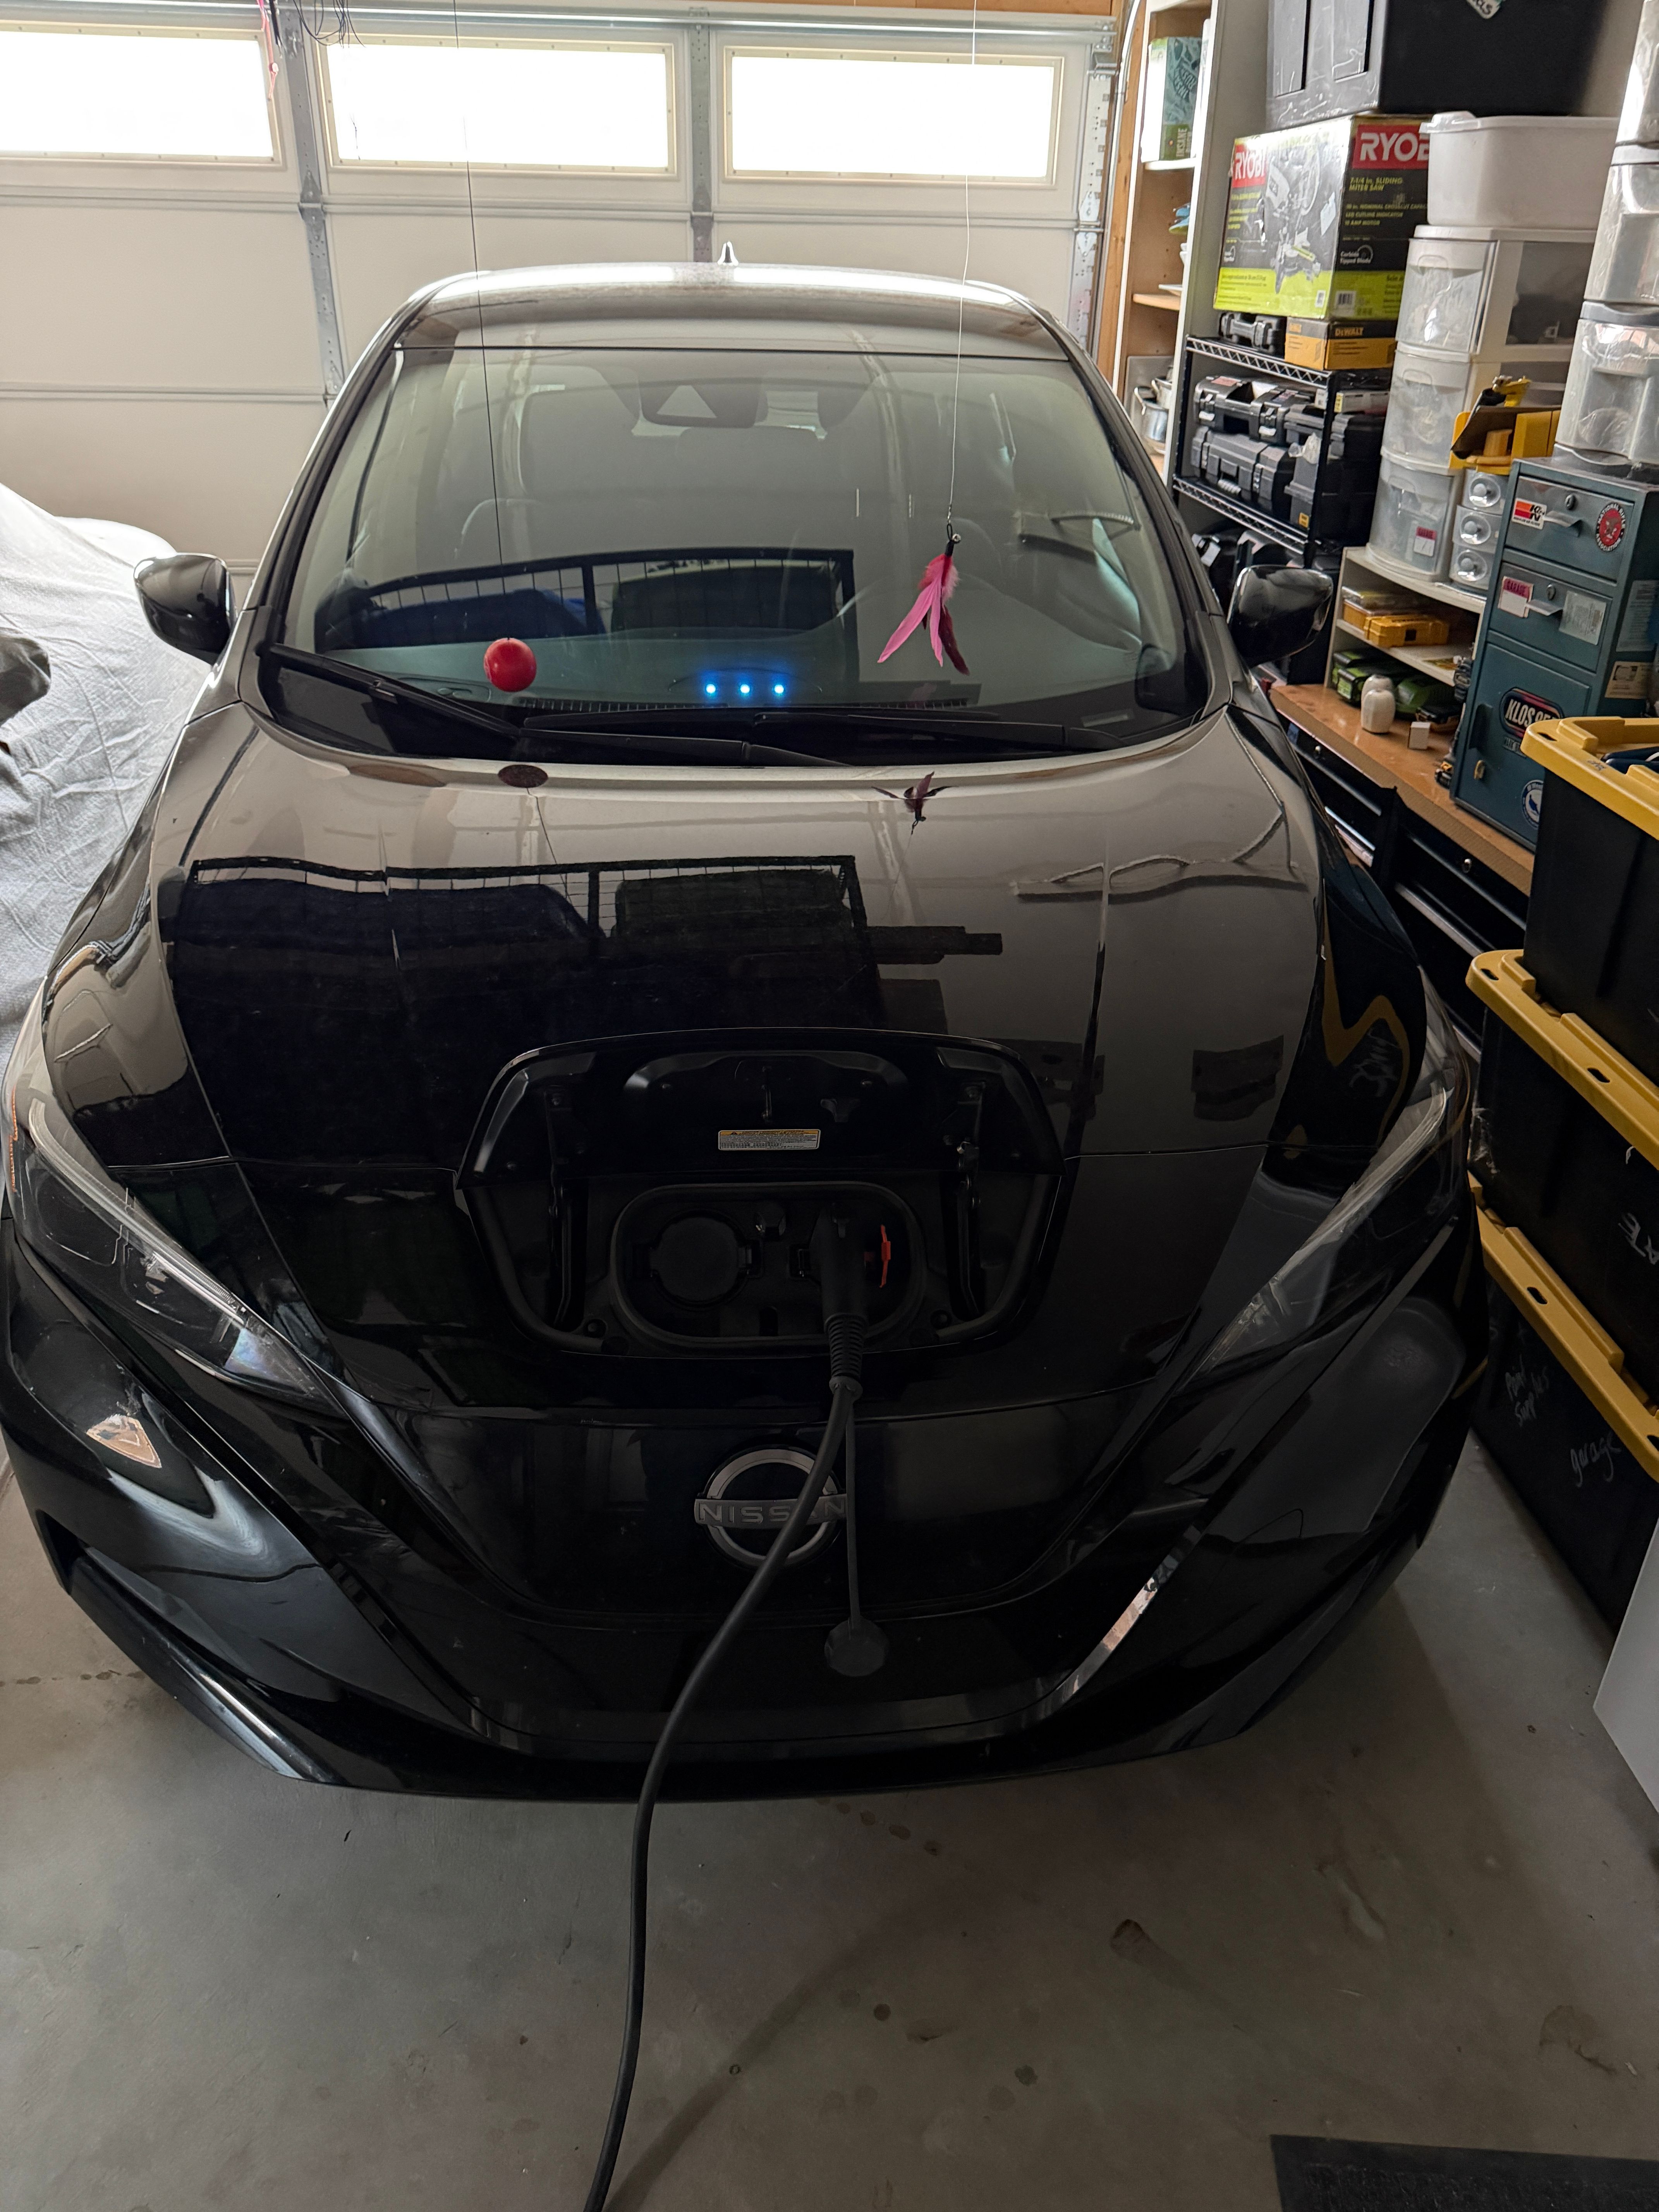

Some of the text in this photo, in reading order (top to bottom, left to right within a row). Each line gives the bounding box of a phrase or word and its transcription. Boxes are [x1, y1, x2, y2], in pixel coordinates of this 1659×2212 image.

[1360, 132, 1430, 161] RYOB
[1235, 148, 1266, 180] RYOBI
[1505, 699, 1536, 728] KLOS
[1570, 1431, 1622, 1487] garage
[699, 1500, 846, 1523] NISSN
